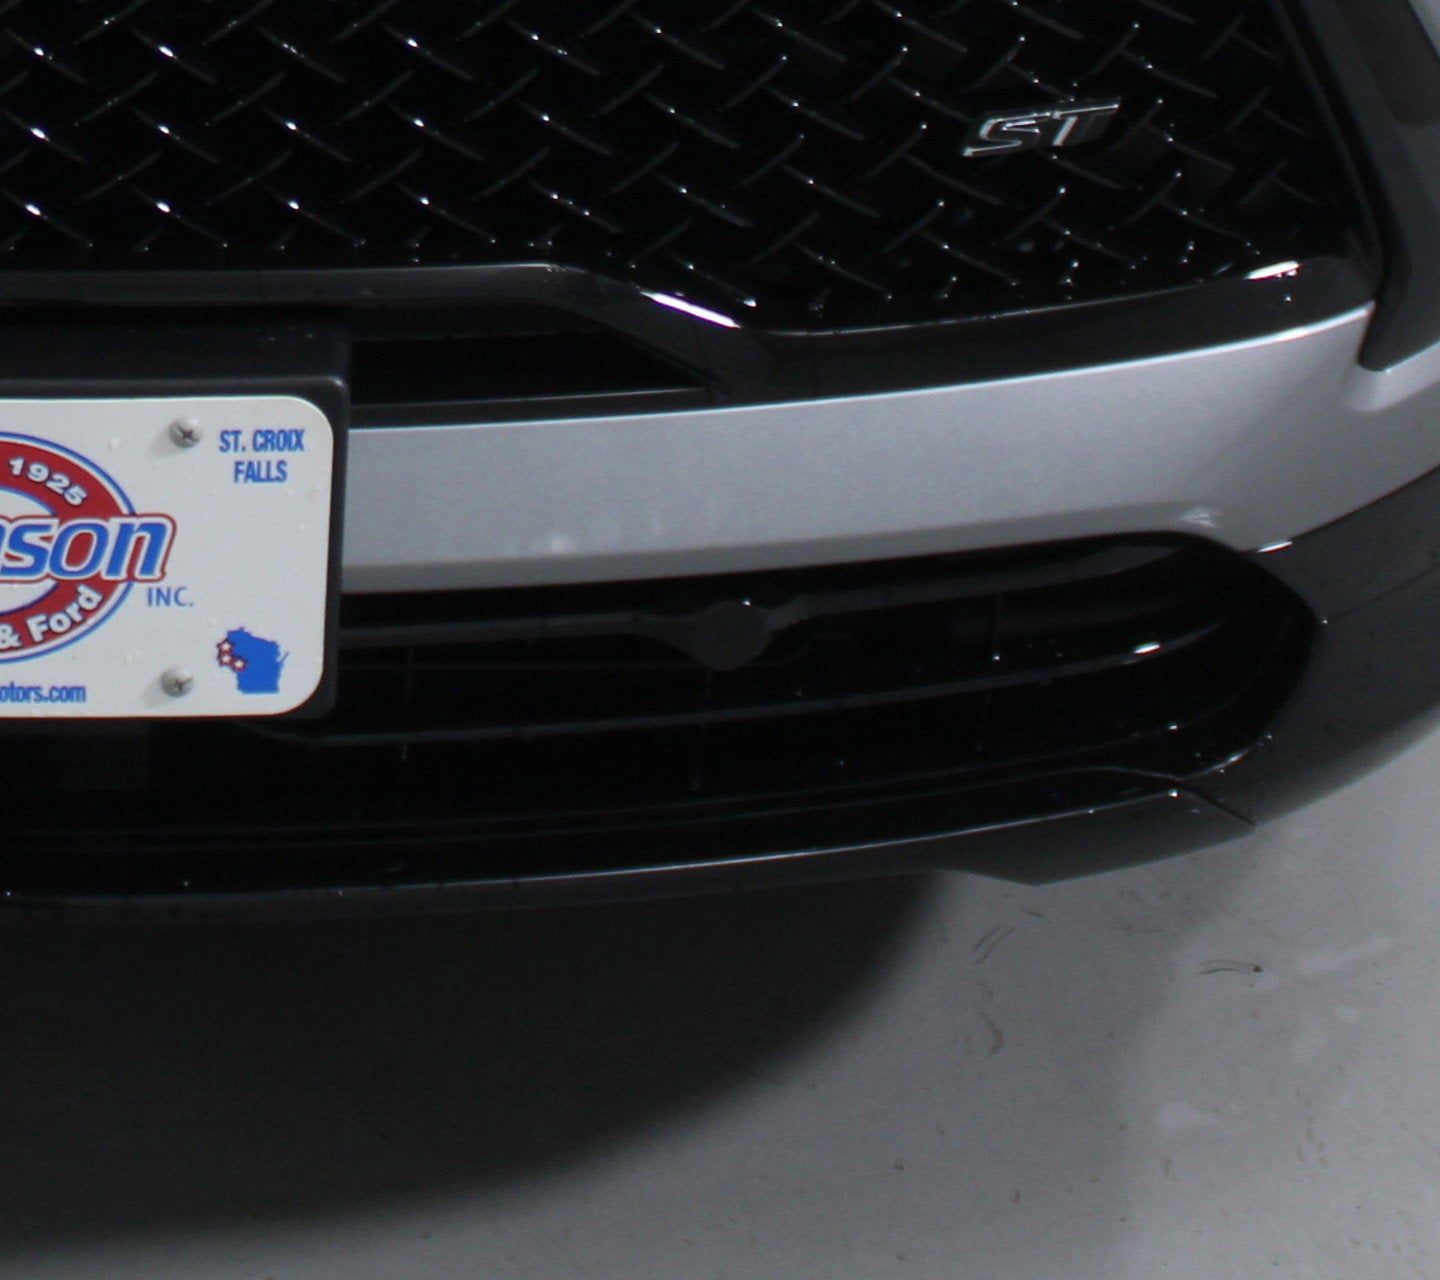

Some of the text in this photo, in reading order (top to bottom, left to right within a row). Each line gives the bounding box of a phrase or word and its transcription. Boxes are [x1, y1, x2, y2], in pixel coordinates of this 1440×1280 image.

[963, 98, 1120, 157] ST
[219, 429, 305, 453] ST. CROIX
[8, 456, 89, 507] 1925
[234, 460, 288, 483] FALLS
[25, 583, 104, 643] Ford
[147, 587, 195, 608] INC.
